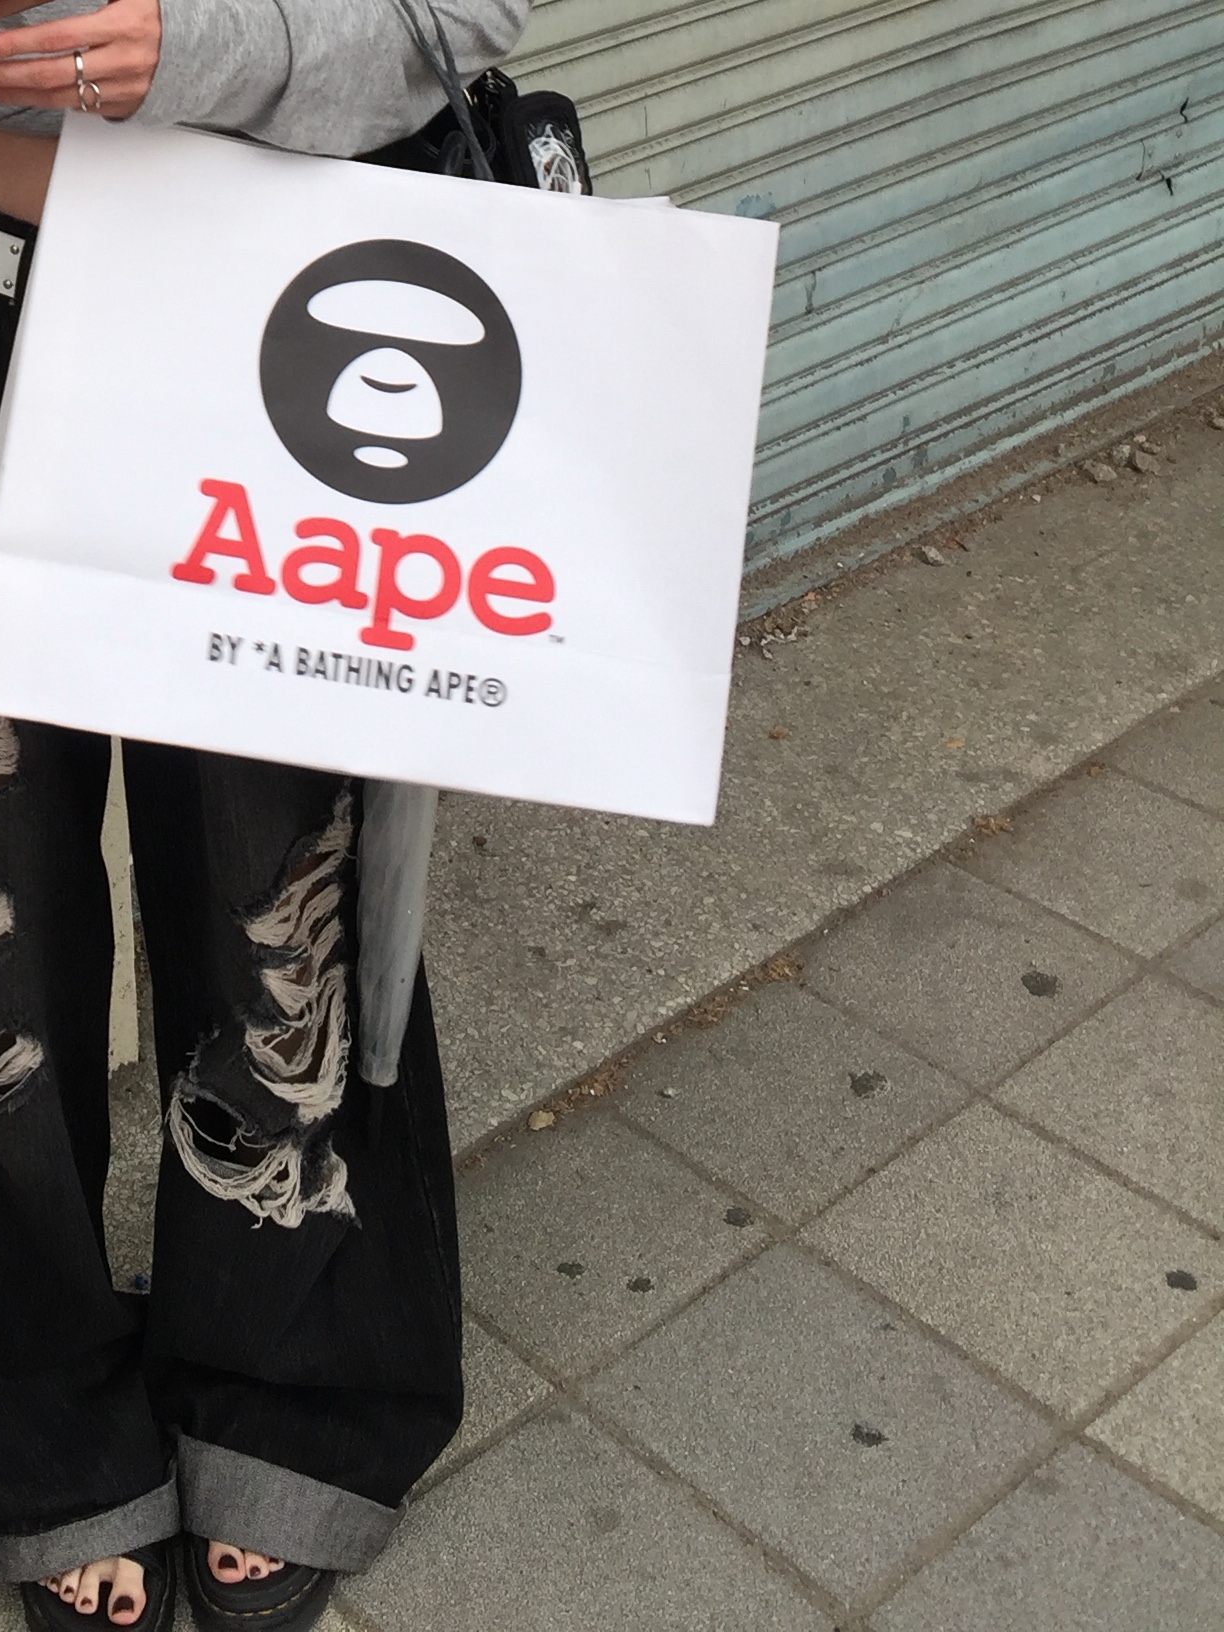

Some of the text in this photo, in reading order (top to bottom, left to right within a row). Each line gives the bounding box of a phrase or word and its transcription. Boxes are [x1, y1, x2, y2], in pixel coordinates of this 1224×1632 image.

[171, 477, 555, 651] Aape
[206, 630, 244, 666] BY
[295, 646, 415, 694] BATHING
